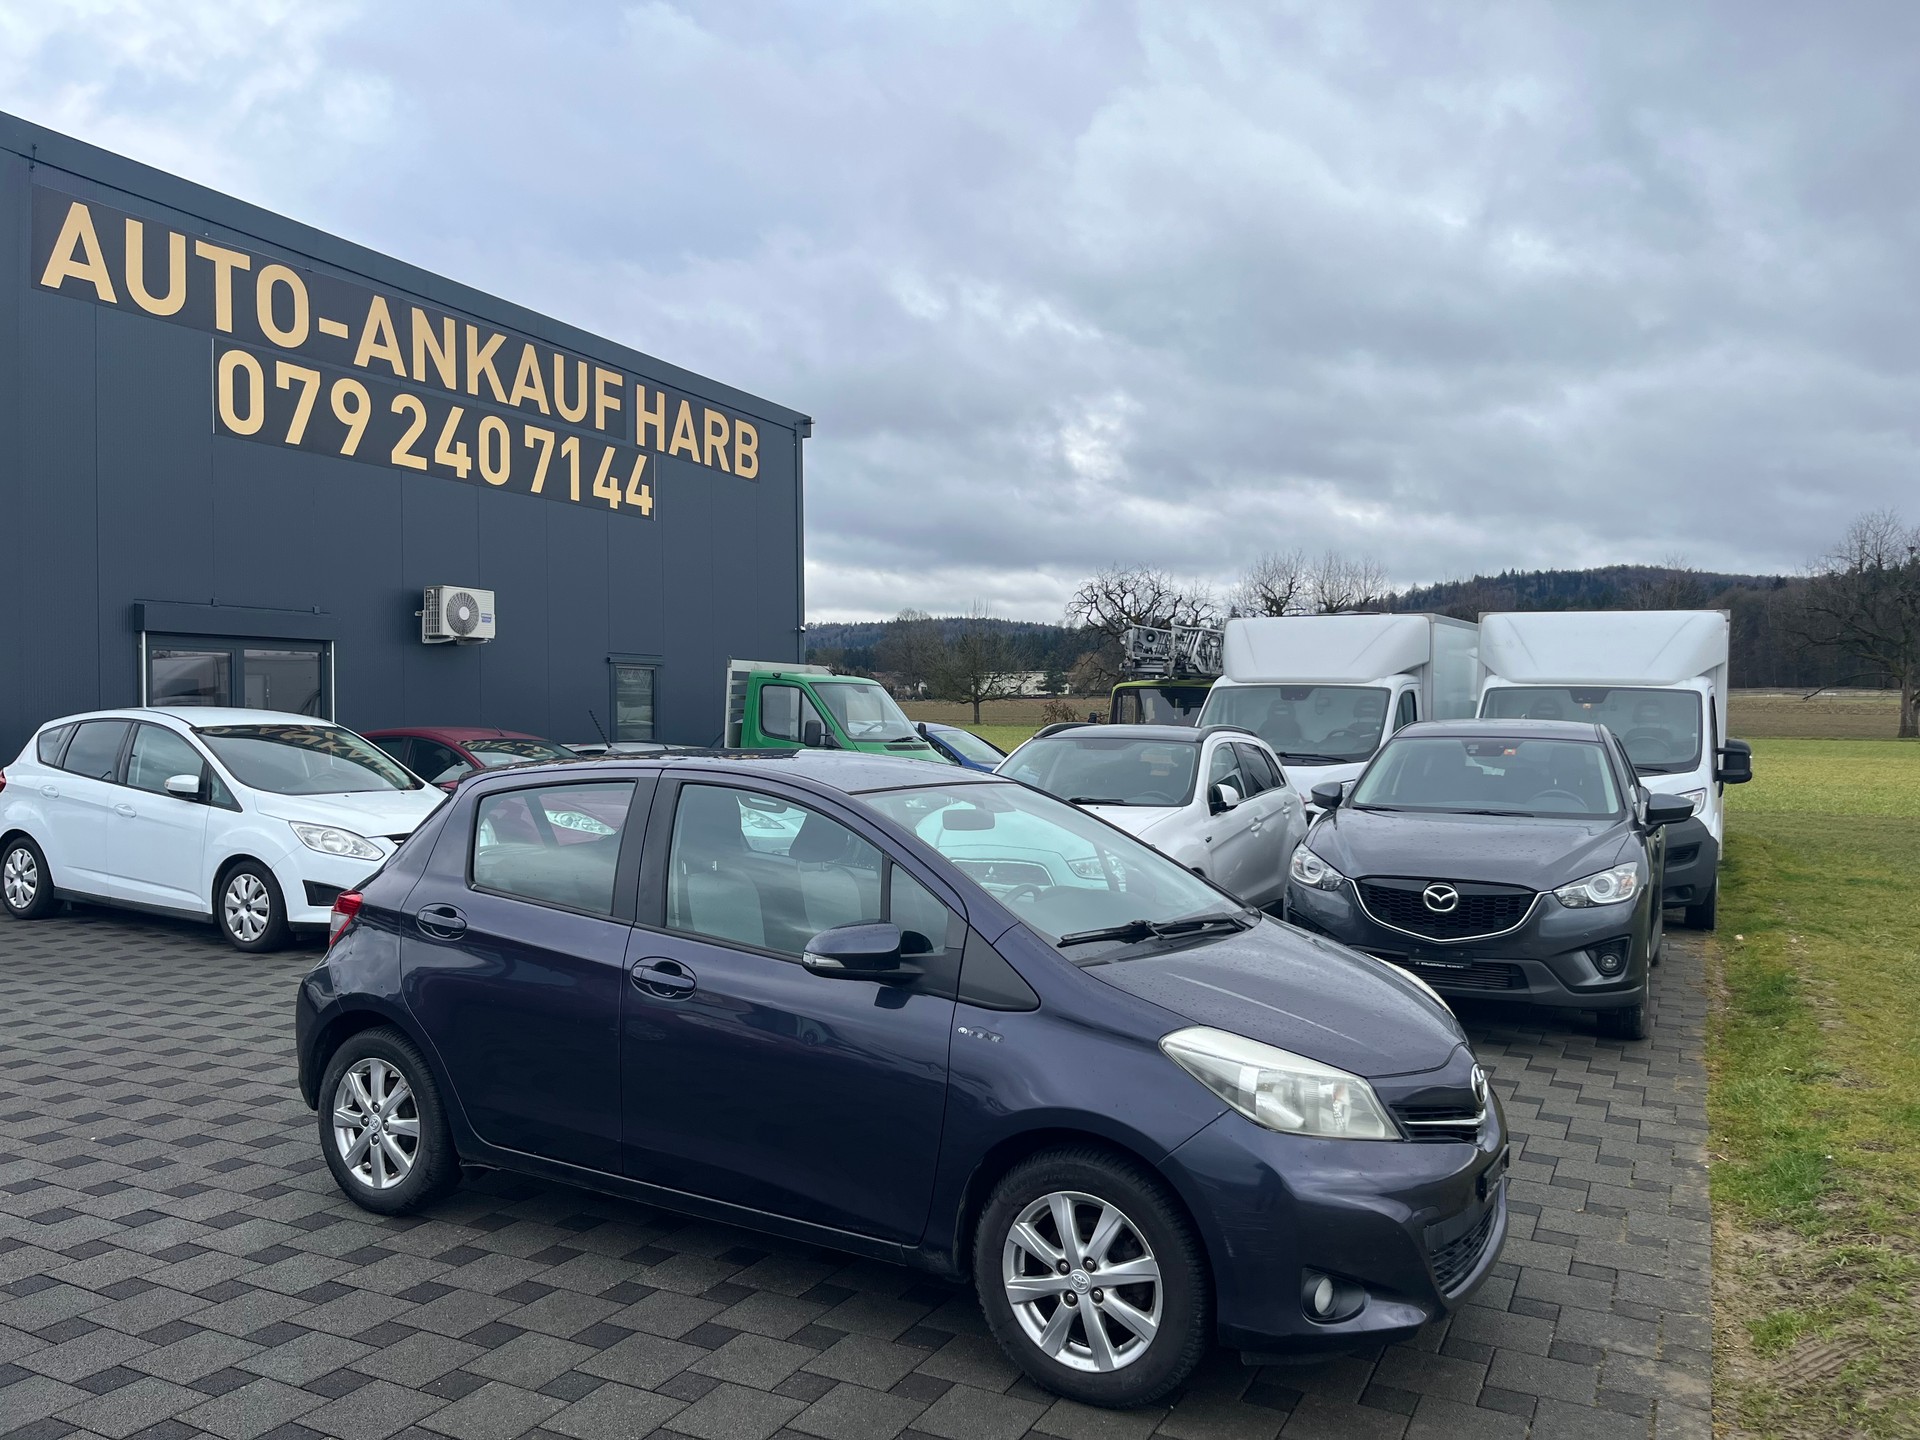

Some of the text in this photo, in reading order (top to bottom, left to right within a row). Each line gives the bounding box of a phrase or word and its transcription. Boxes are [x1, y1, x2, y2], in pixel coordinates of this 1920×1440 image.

[41, 201, 760, 480] AUTO-ANKAUF HARB
[218, 349, 372, 456] 079
[390, 393, 512, 487] 240
